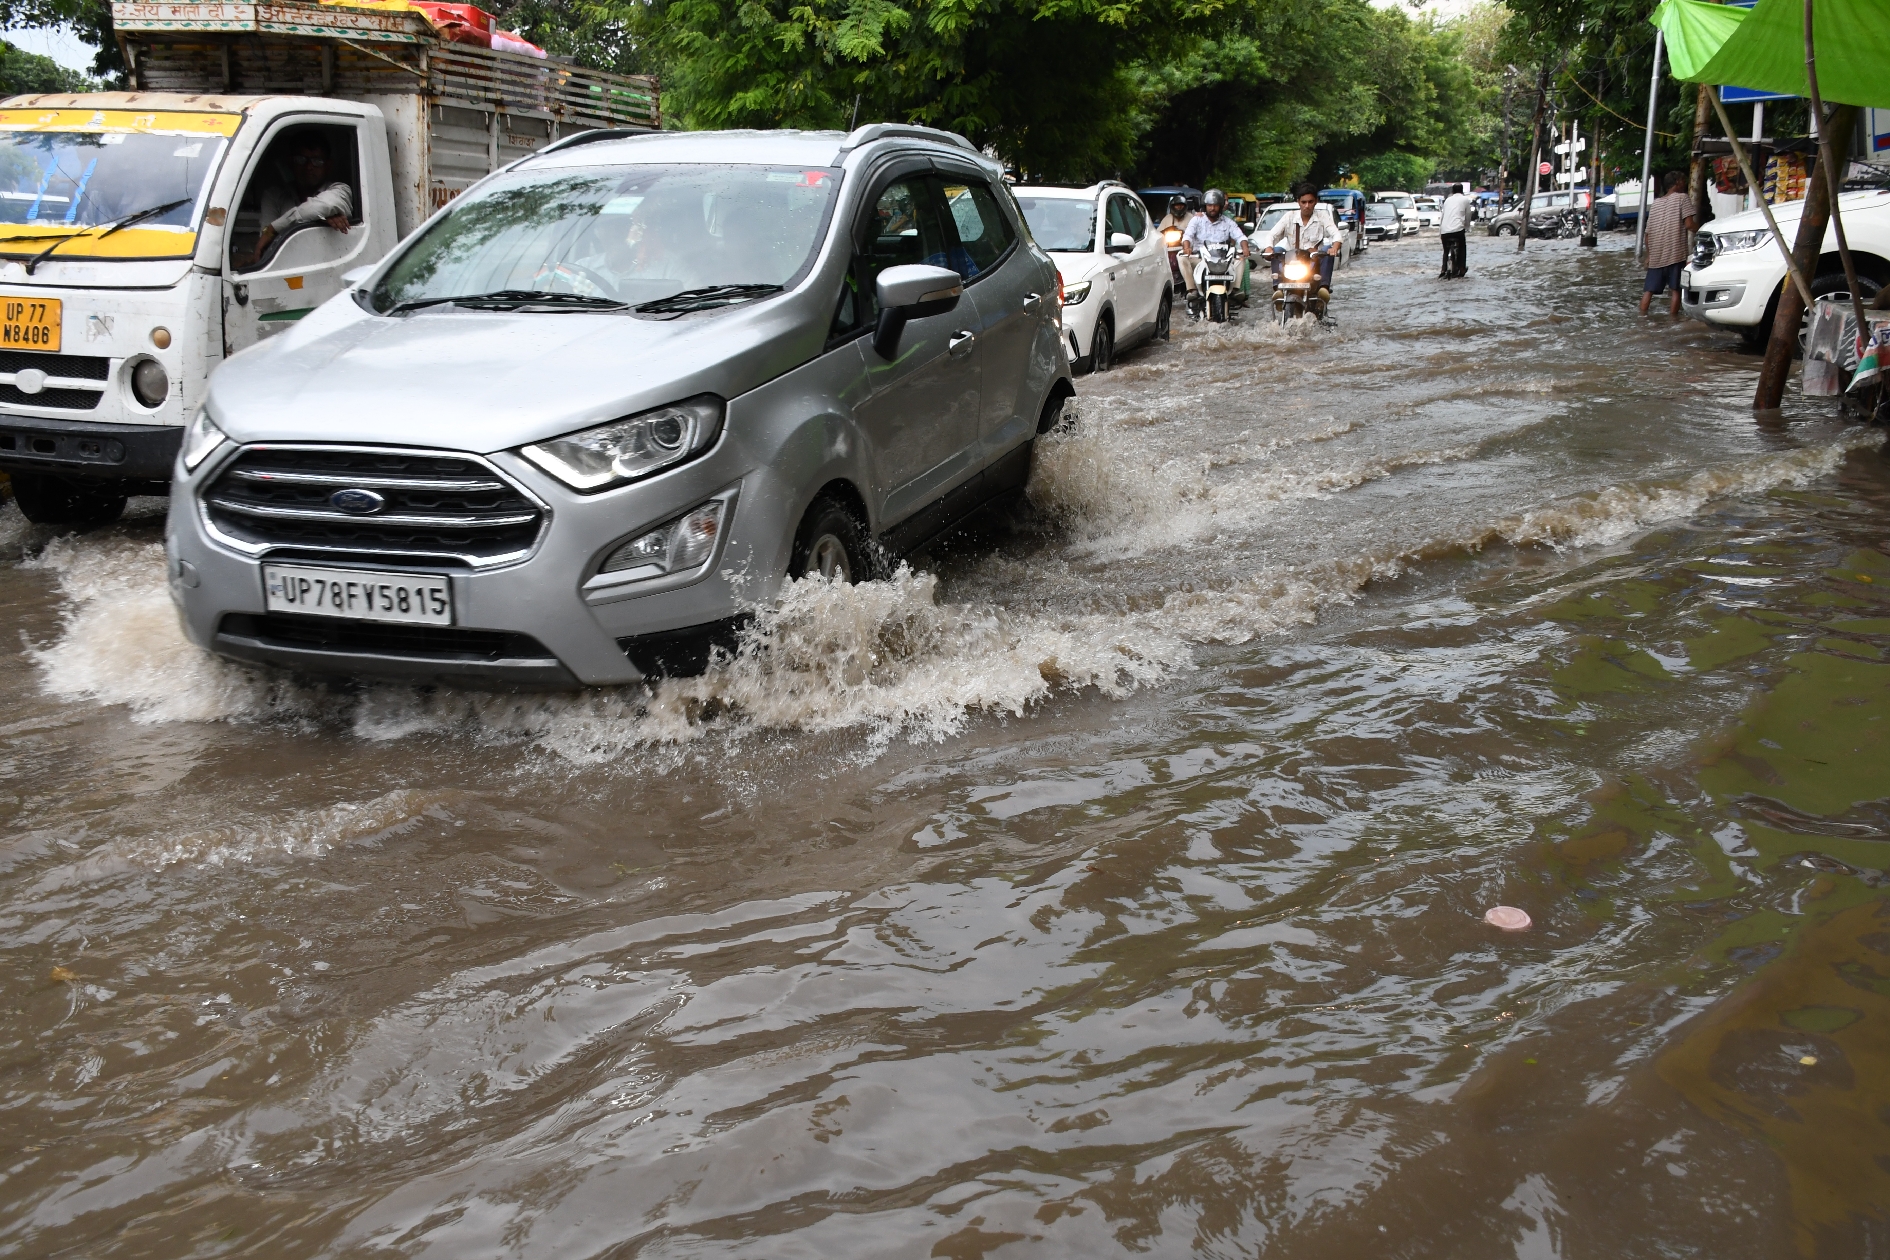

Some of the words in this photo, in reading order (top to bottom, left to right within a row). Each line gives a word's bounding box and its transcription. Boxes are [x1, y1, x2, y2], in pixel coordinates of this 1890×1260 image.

[130, 4, 162, 18] जय
[168, 5, 200, 19] माता
[204, 5, 225, 20] दी
[7, 302, 23, 321] UP
[29, 304, 46, 322] 77
[3, 324, 50, 344] N8406
